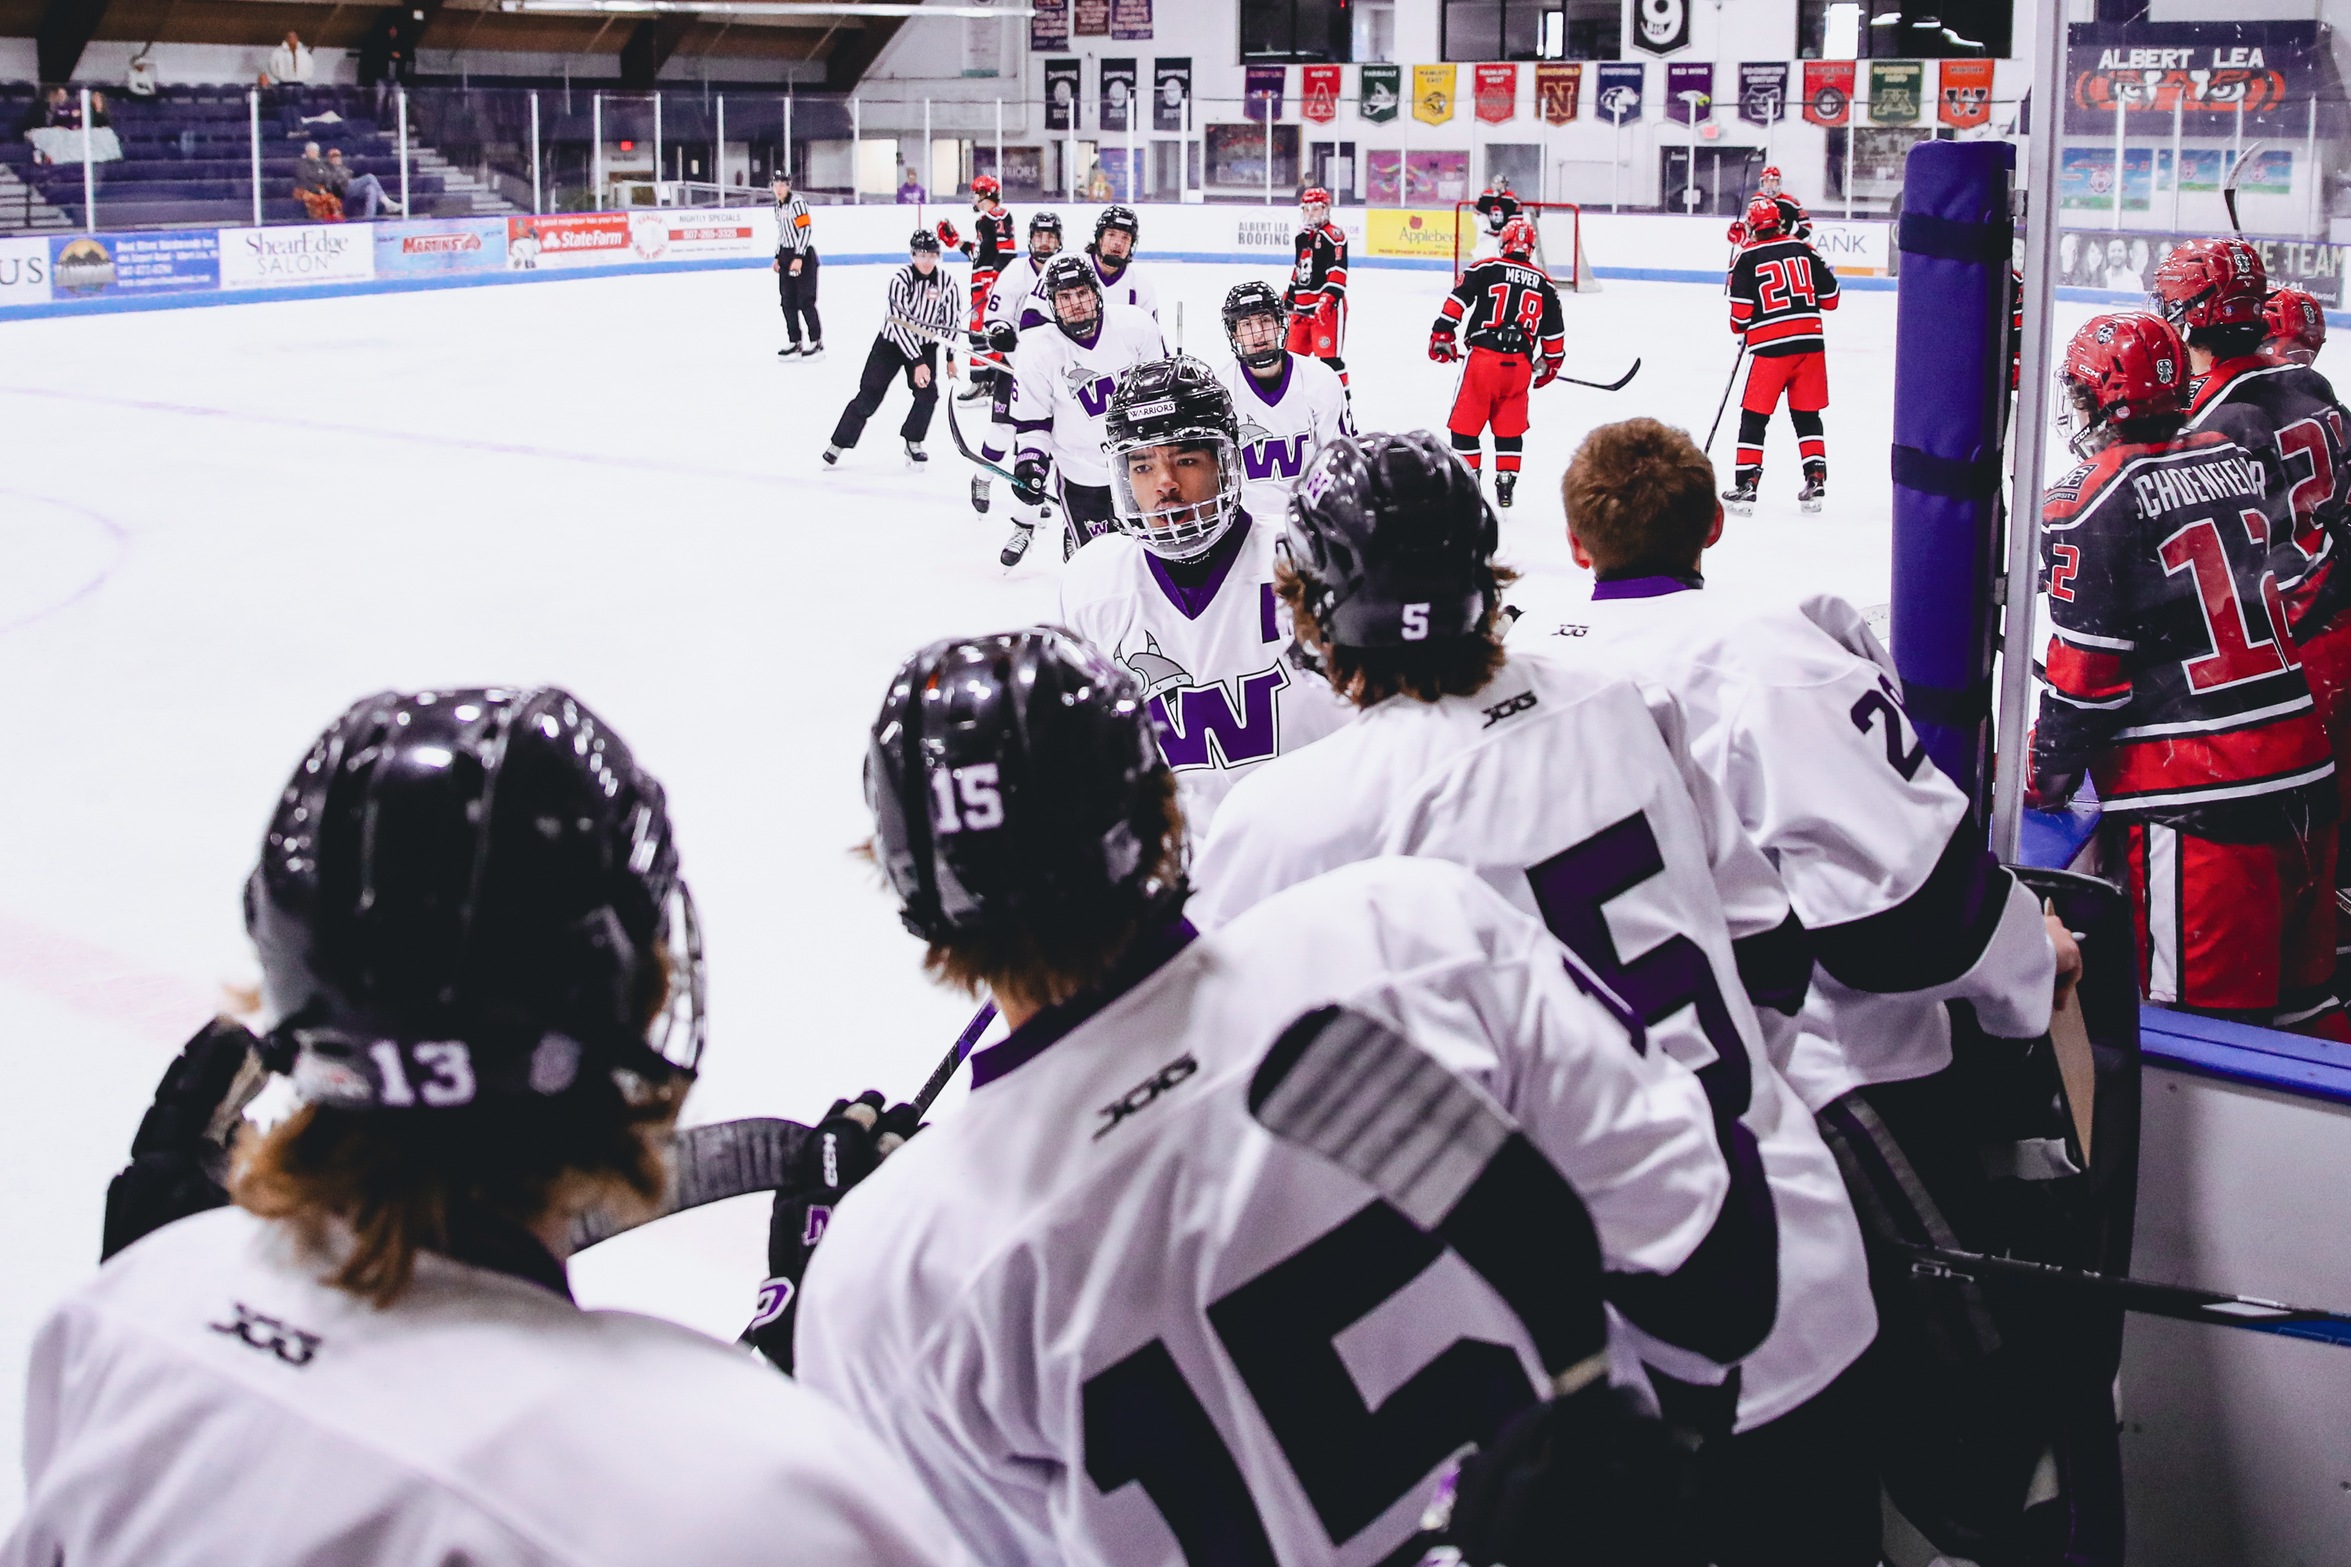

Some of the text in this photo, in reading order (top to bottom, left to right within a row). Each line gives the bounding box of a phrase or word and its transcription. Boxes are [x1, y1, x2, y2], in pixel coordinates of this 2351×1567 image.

[1641, 0, 1683, 44] 9
[2097, 47, 2265, 70] ALBERT LEA
[1543, 82, 1575, 116] N
[679, 213, 742, 223] NIGHTLY SPECIALS
[1238, 222, 1290, 233] ALBERT LEA
[245, 229, 349, 259] ShearEdge
[1238, 232, 1290, 246] ROOFING
[1810, 234, 1867, 254] ANK
[257, 254, 329, 275] SALON
[2283, 241, 2346, 278] TEAM
[1505, 267, 1540, 289] MEYER
[1755, 256, 1816, 314] 24
[1481, 282, 1543, 336] 18
[2078, 363, 2101, 379] CCM
[1127, 402, 1176, 418] WARRIORS
[2073, 426, 2092, 444] CCM
[1241, 431, 1313, 482] W
[1401, 602, 1431, 641] 5
[1148, 657, 1290, 774] W
[932, 762, 1005, 834] 15
[1524, 808, 1753, 1122] 5
[368, 1038, 477, 1107] 13
[1082, 1198, 1545, 1567] 15
